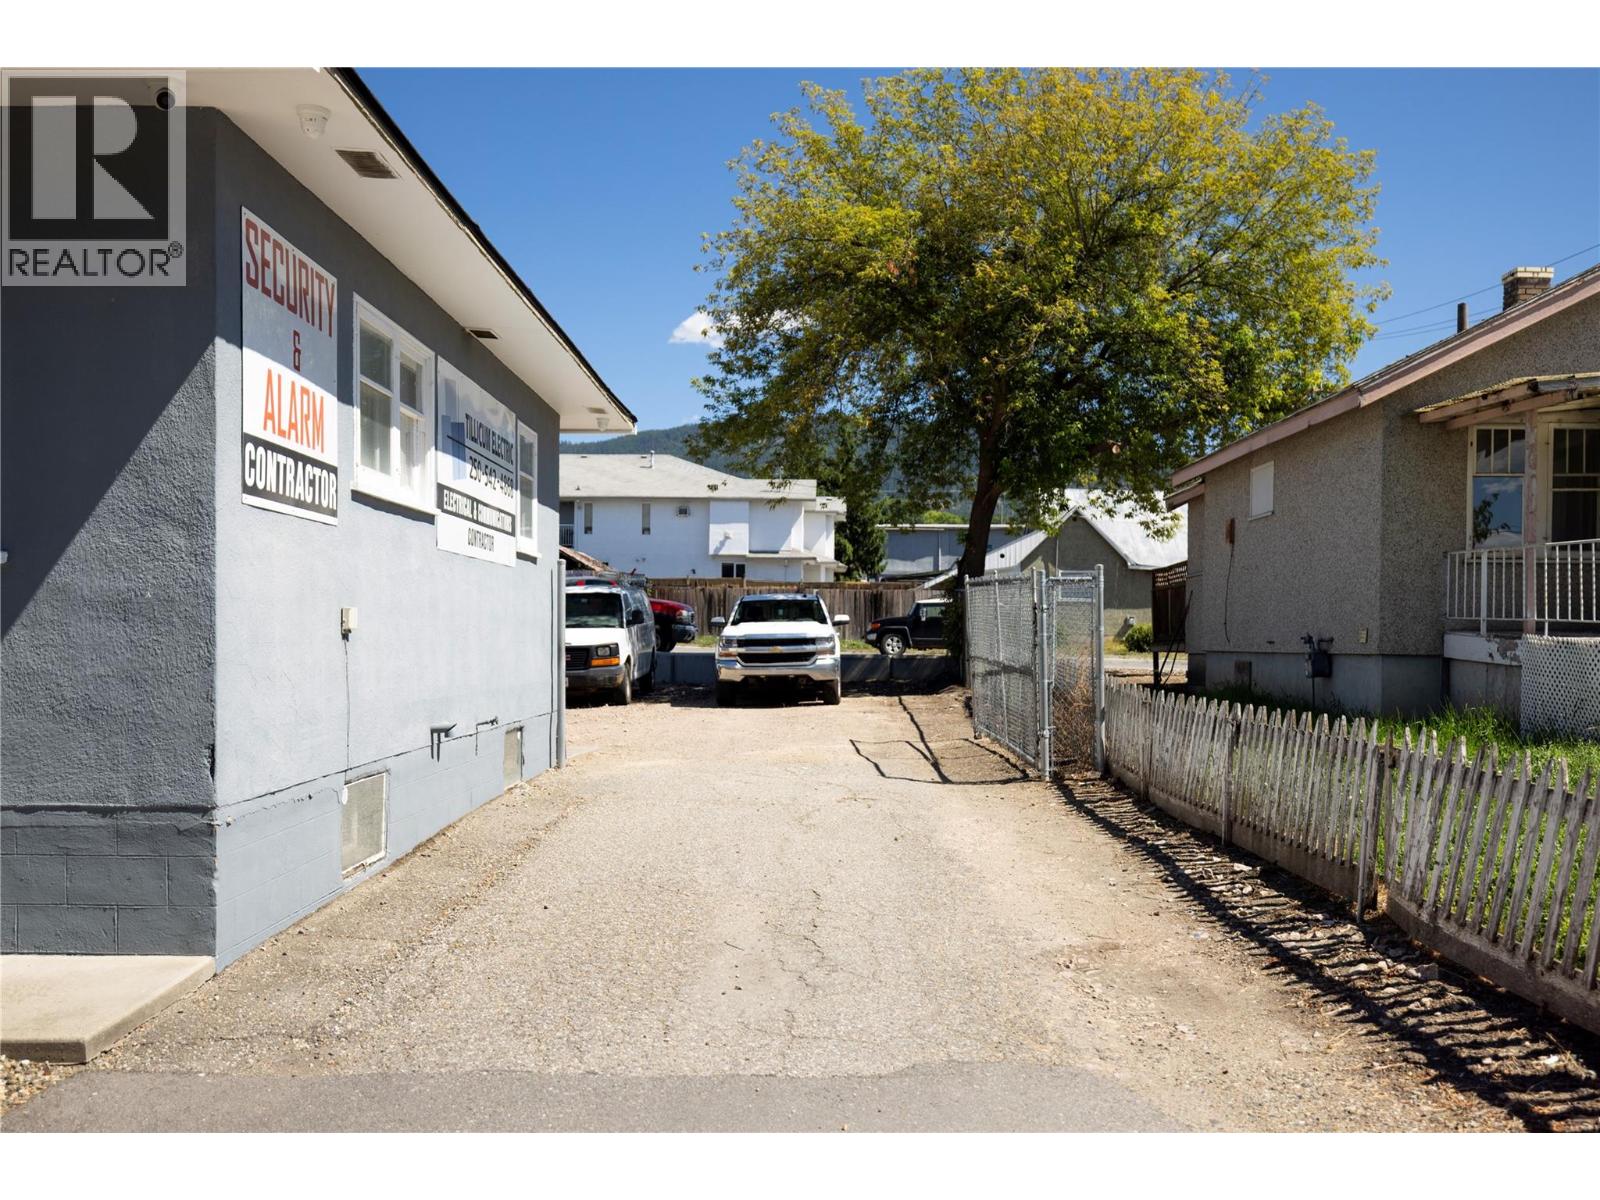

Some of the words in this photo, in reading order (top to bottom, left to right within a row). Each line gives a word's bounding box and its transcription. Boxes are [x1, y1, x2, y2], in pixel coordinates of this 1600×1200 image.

[245, 217, 335, 338] SECURITY
[293, 329, 301, 372] &
[263, 367, 325, 454] ALARM
[465, 412, 491, 452] TILLICUM
[491, 429, 514, 466] ELECTRIC
[244, 442, 338, 510] CONTRACTOR
[467, 527, 495, 553] CONTRACTOR
